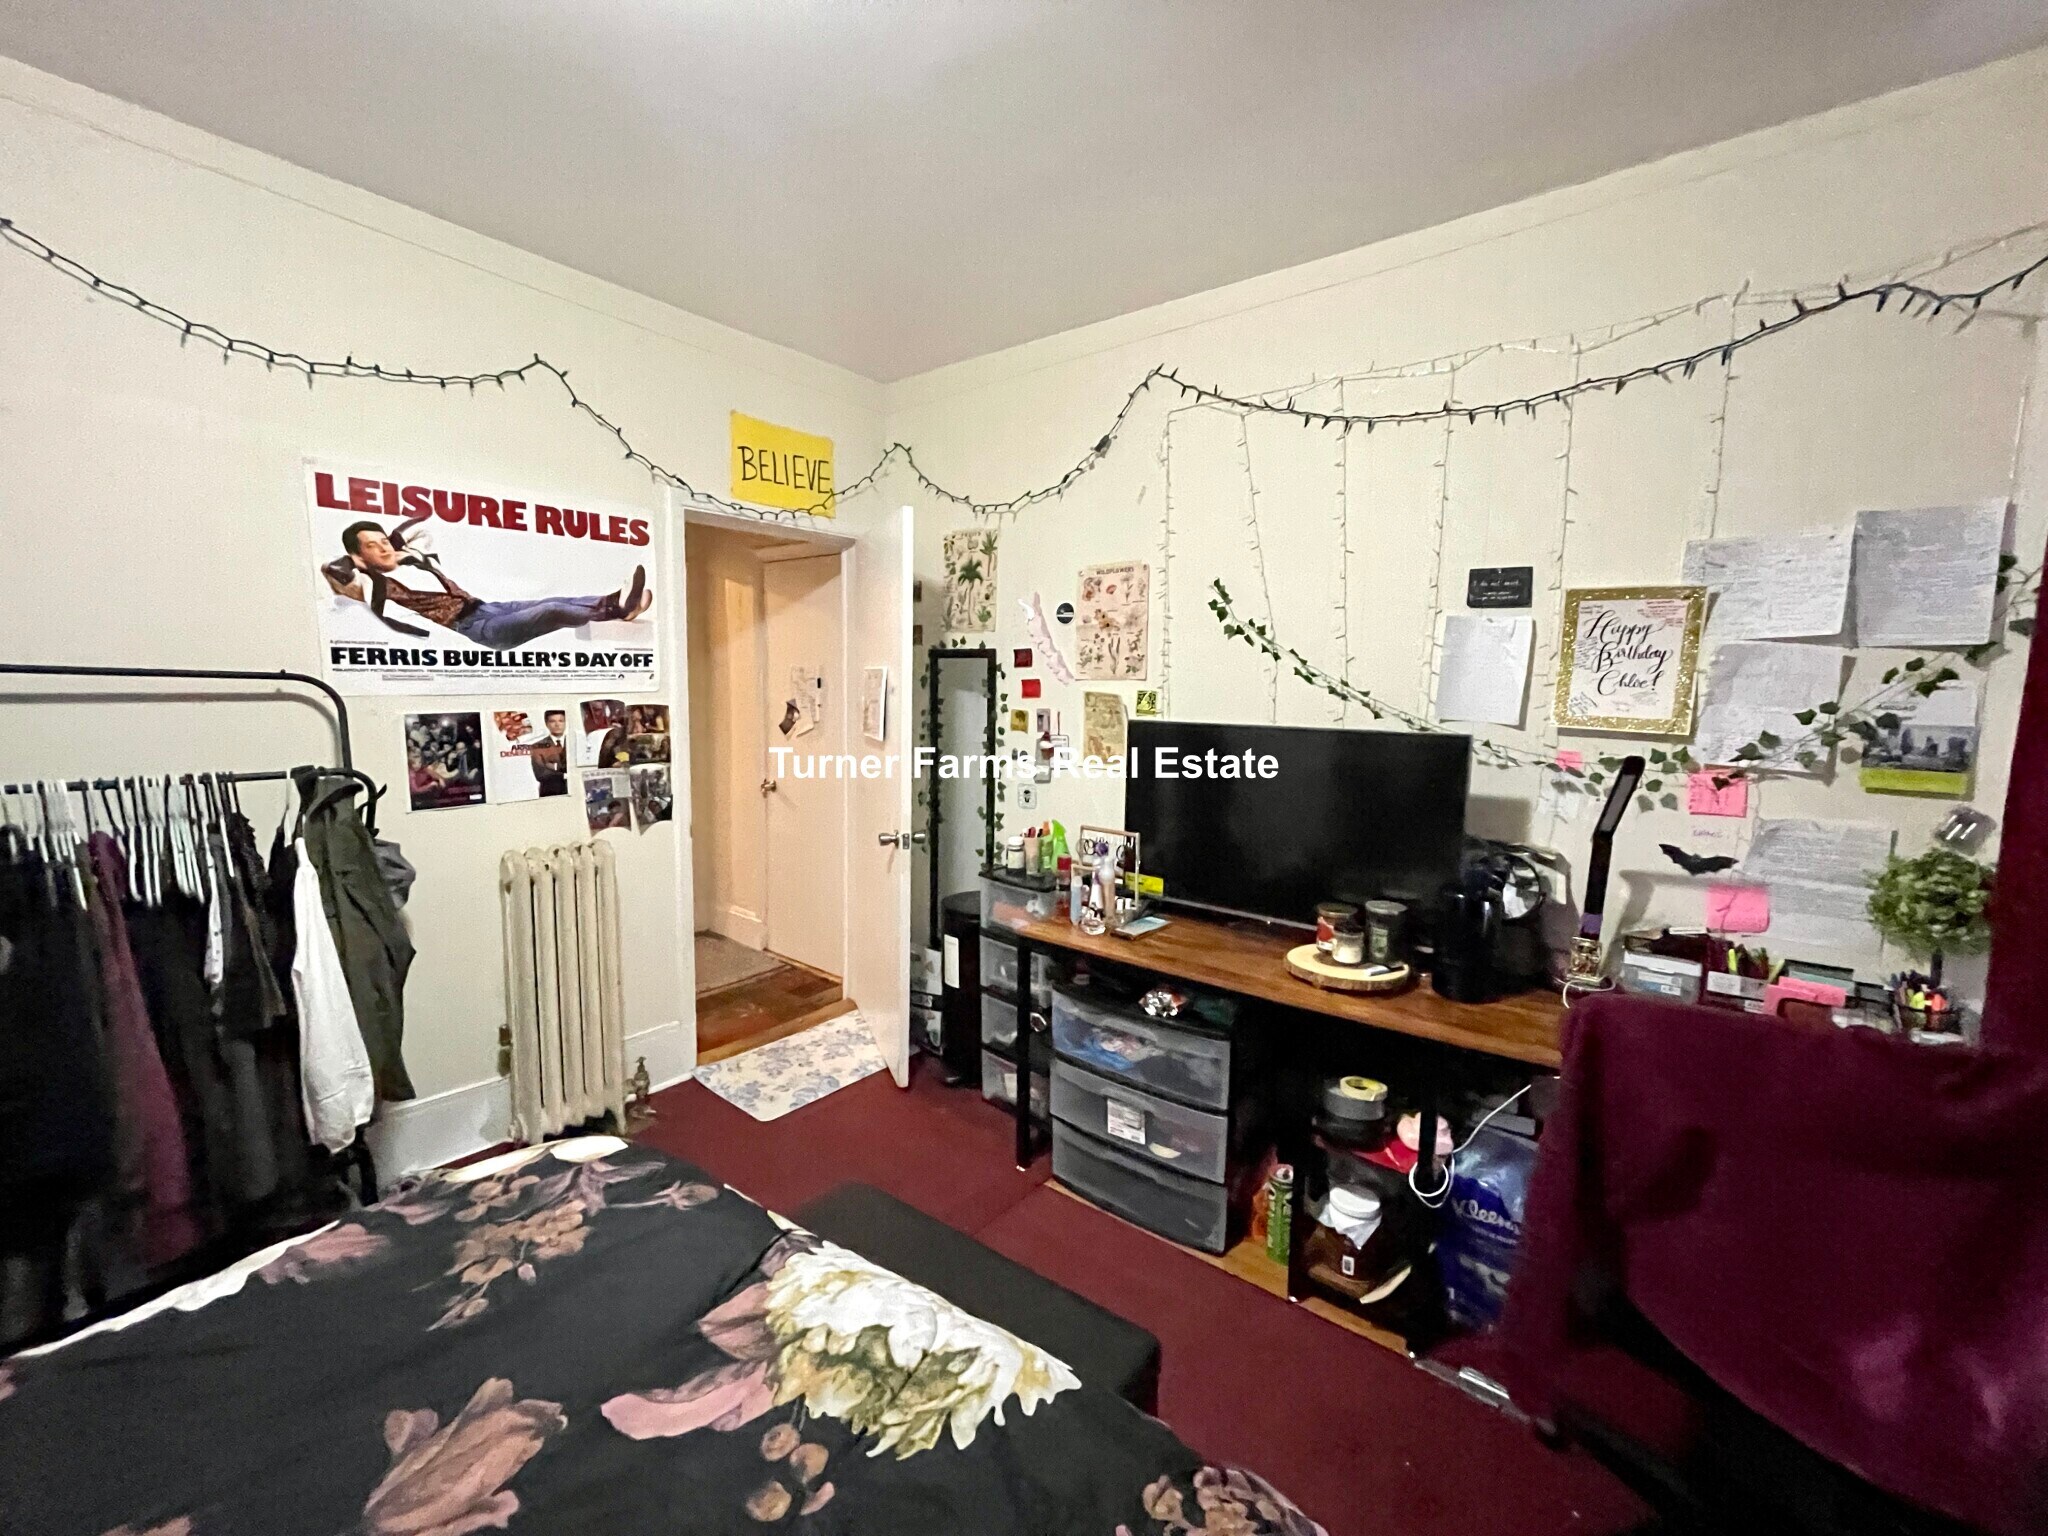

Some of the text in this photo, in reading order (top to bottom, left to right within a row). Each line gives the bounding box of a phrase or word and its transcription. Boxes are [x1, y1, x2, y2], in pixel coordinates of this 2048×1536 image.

[737, 446, 830, 494] BELIEVE
[314, 472, 651, 547] LEISURE RULES
[1583, 609, 1666, 645] Happy
[330, 646, 653, 668] FERRIS BUELLER'S DAY OFF
[1590, 641, 1674, 674] Birthday
